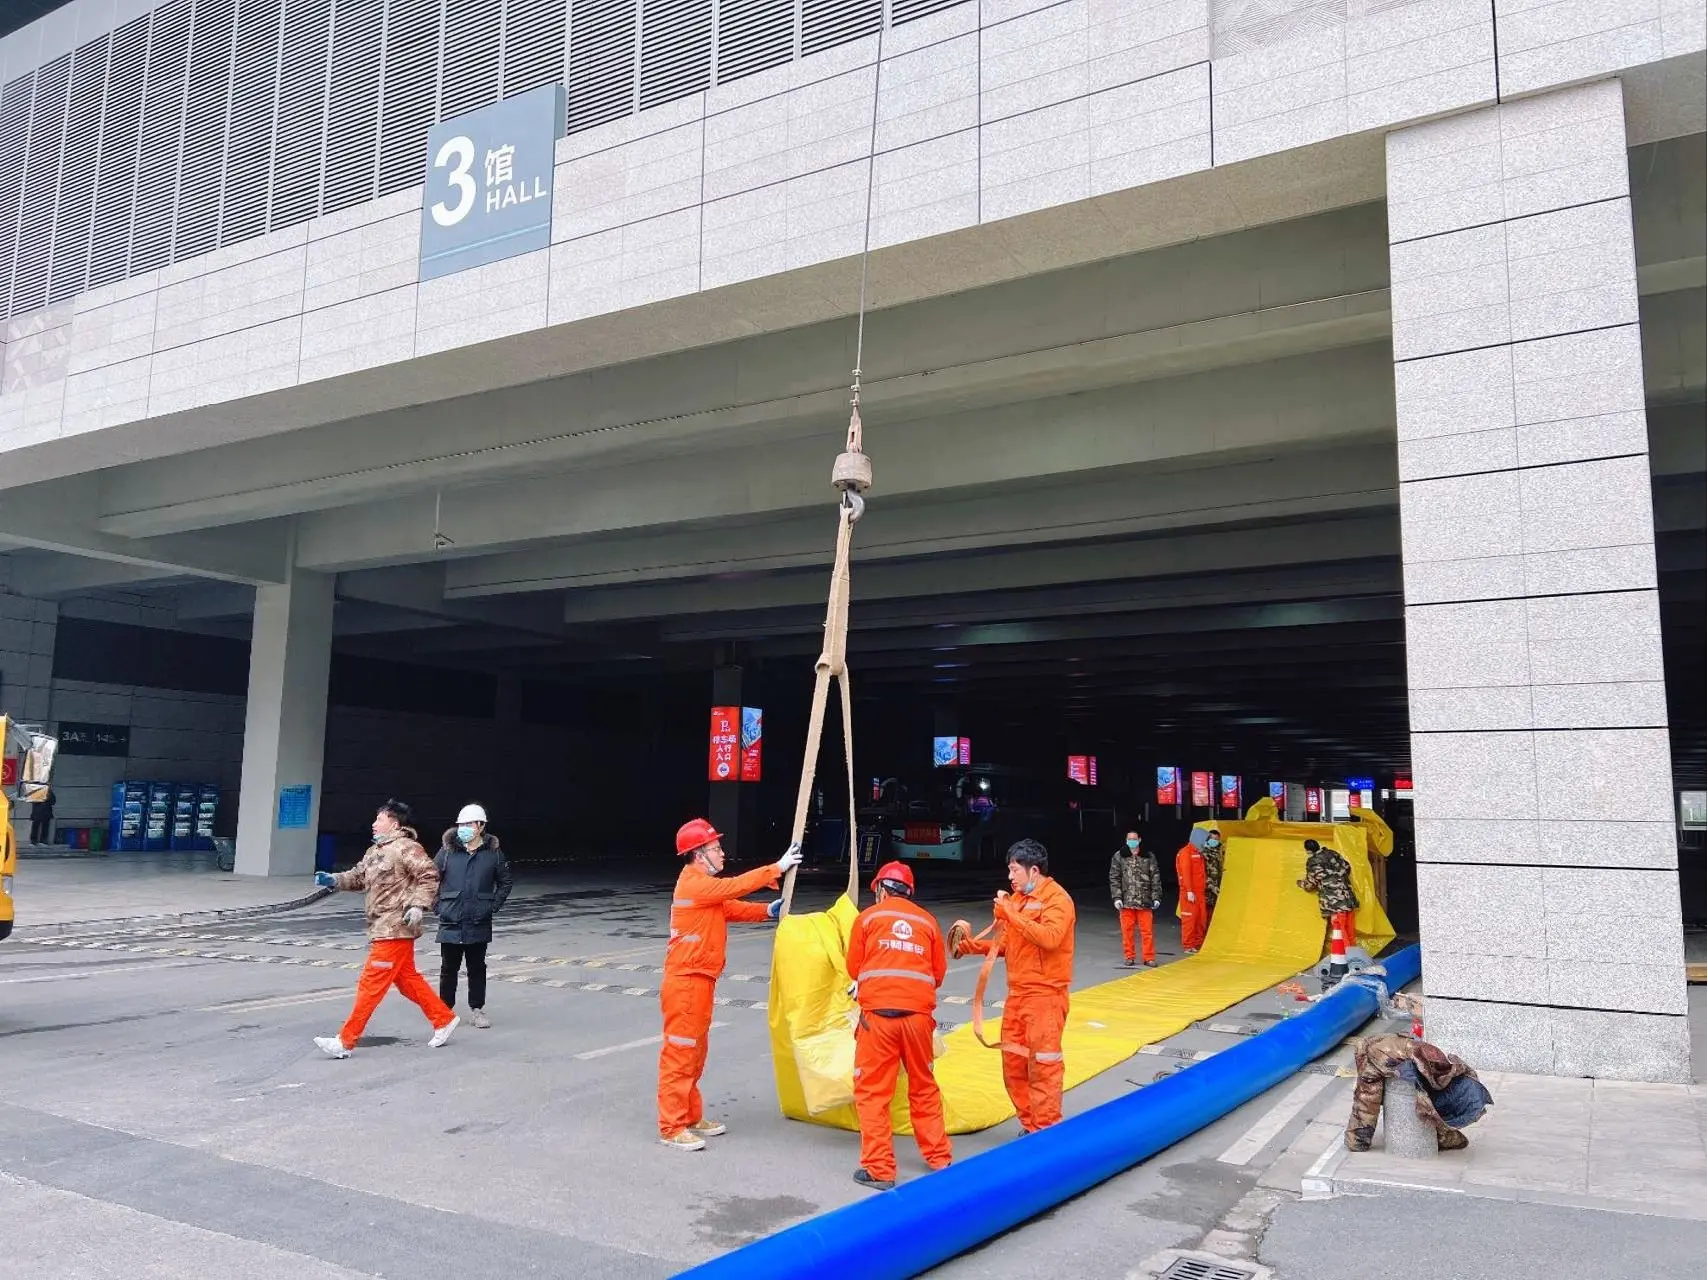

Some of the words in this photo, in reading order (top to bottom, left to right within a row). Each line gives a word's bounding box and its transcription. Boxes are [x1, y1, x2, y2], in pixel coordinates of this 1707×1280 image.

[432, 136, 477, 226] 3
[485, 144, 515, 187] 馆
[485, 176, 547, 213] HALL
